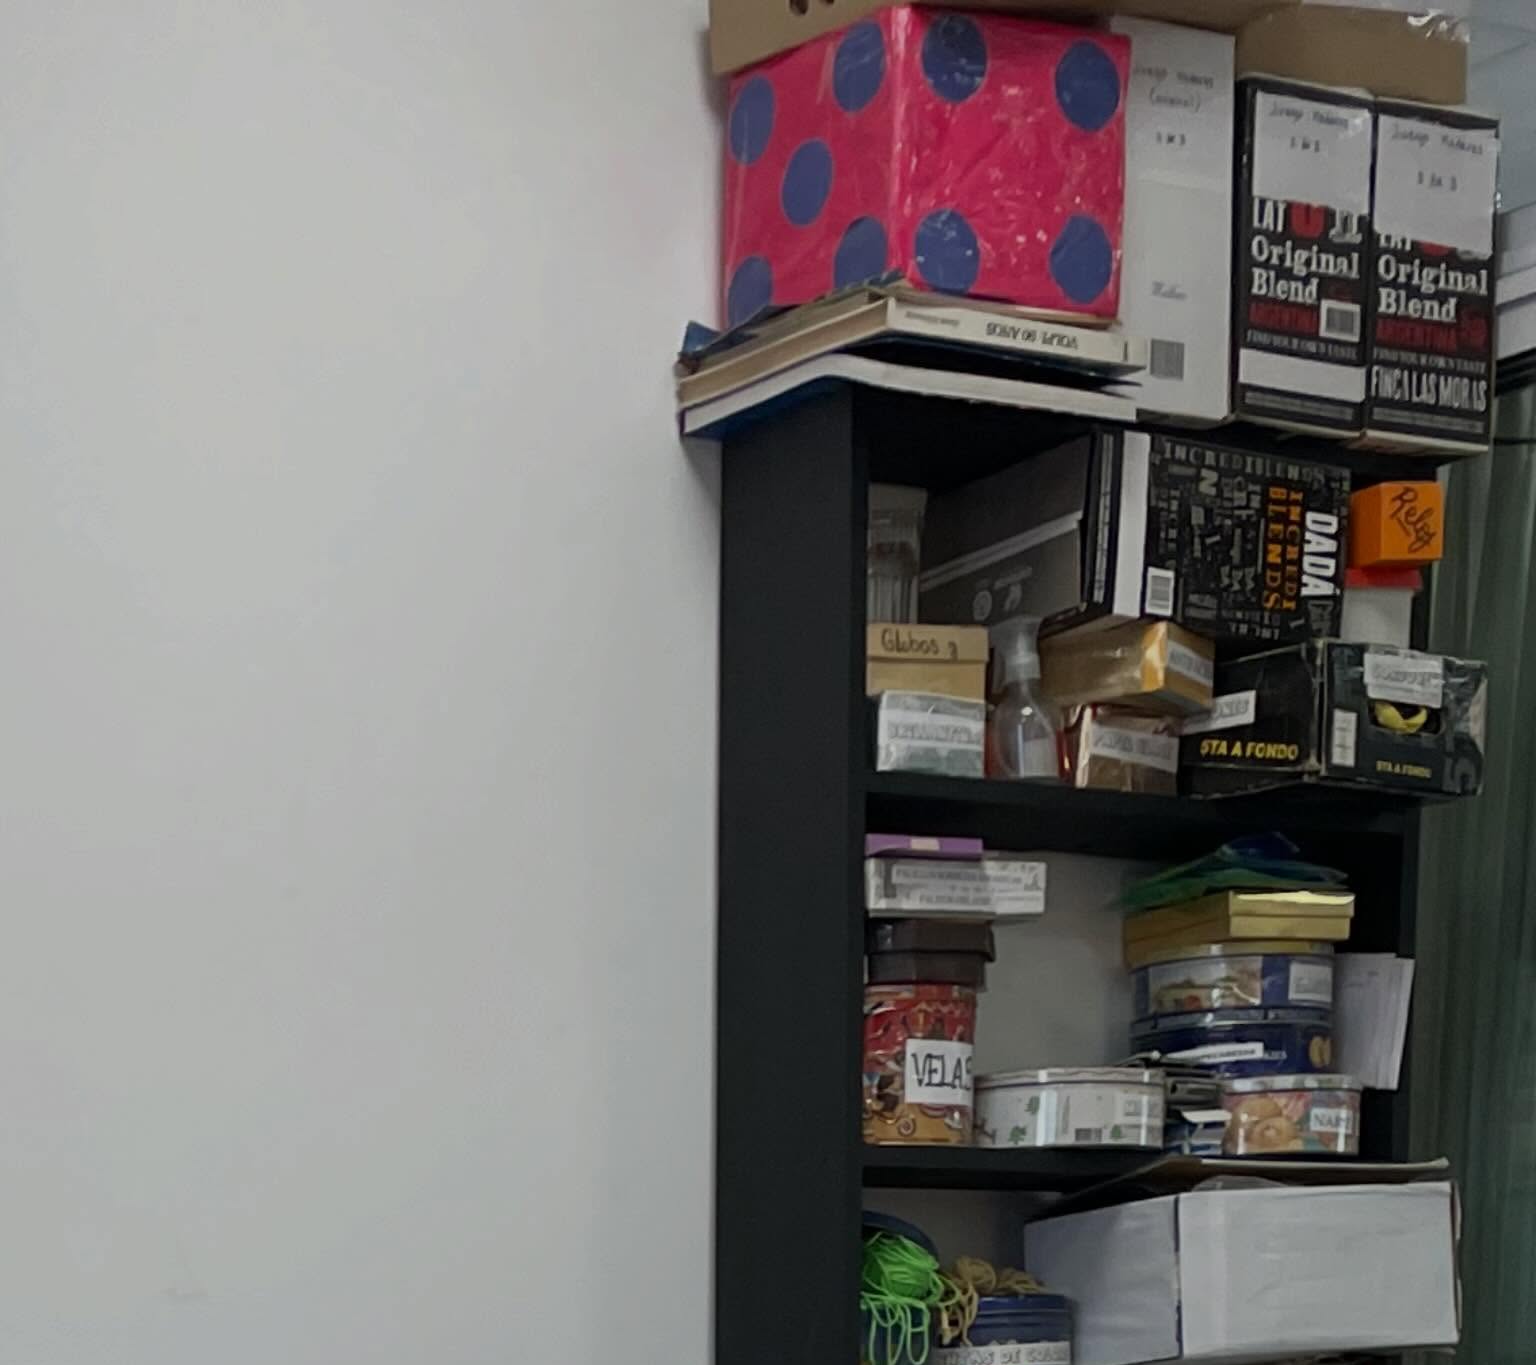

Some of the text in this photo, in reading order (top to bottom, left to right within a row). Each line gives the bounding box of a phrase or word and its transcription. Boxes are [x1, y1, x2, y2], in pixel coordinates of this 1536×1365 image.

[1251, 234, 1362, 280] Original
[1377, 253, 1489, 296] Original
[1250, 267, 1320, 304] Blend
[1377, 287, 1458, 323] Blend
[1371, 364, 1488, 412] FINCA LAS MORAS
[1300, 511, 1342, 597] DADÁ
[1245, 741, 1300, 761] FONDO
